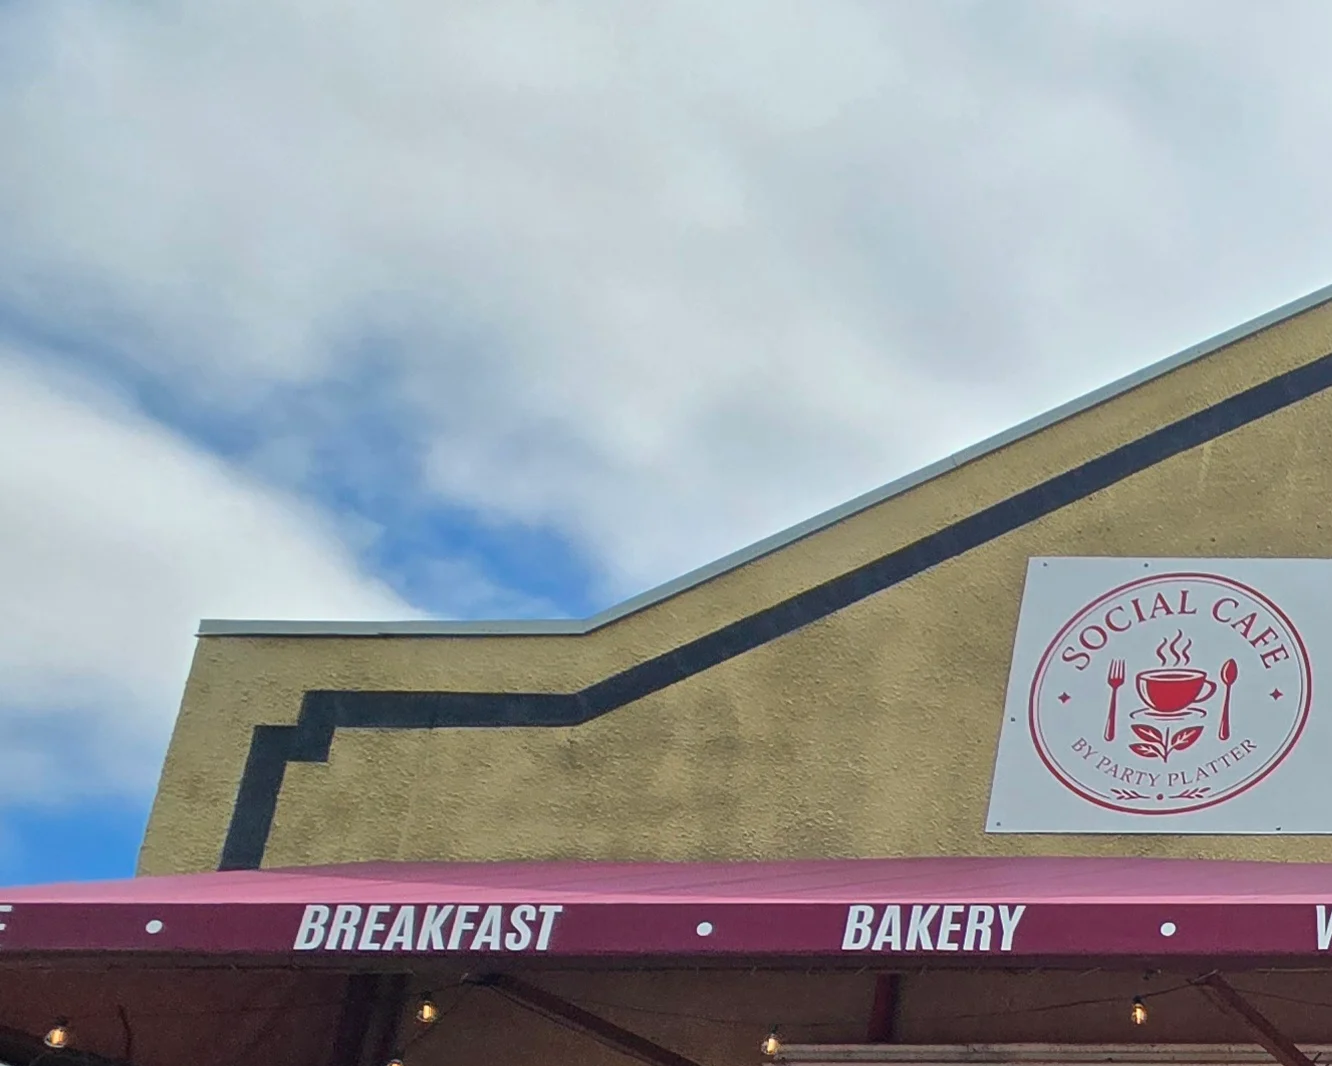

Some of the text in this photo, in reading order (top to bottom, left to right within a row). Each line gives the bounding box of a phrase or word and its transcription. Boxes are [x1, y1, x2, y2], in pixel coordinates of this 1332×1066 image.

[1062, 589, 1290, 672] SOCIAL CAFE
[1071, 737, 1258, 787] BY PARTY PLATTER
[294, 905, 563, 951] BREAKFAST
[842, 905, 1026, 951] BAKERY
